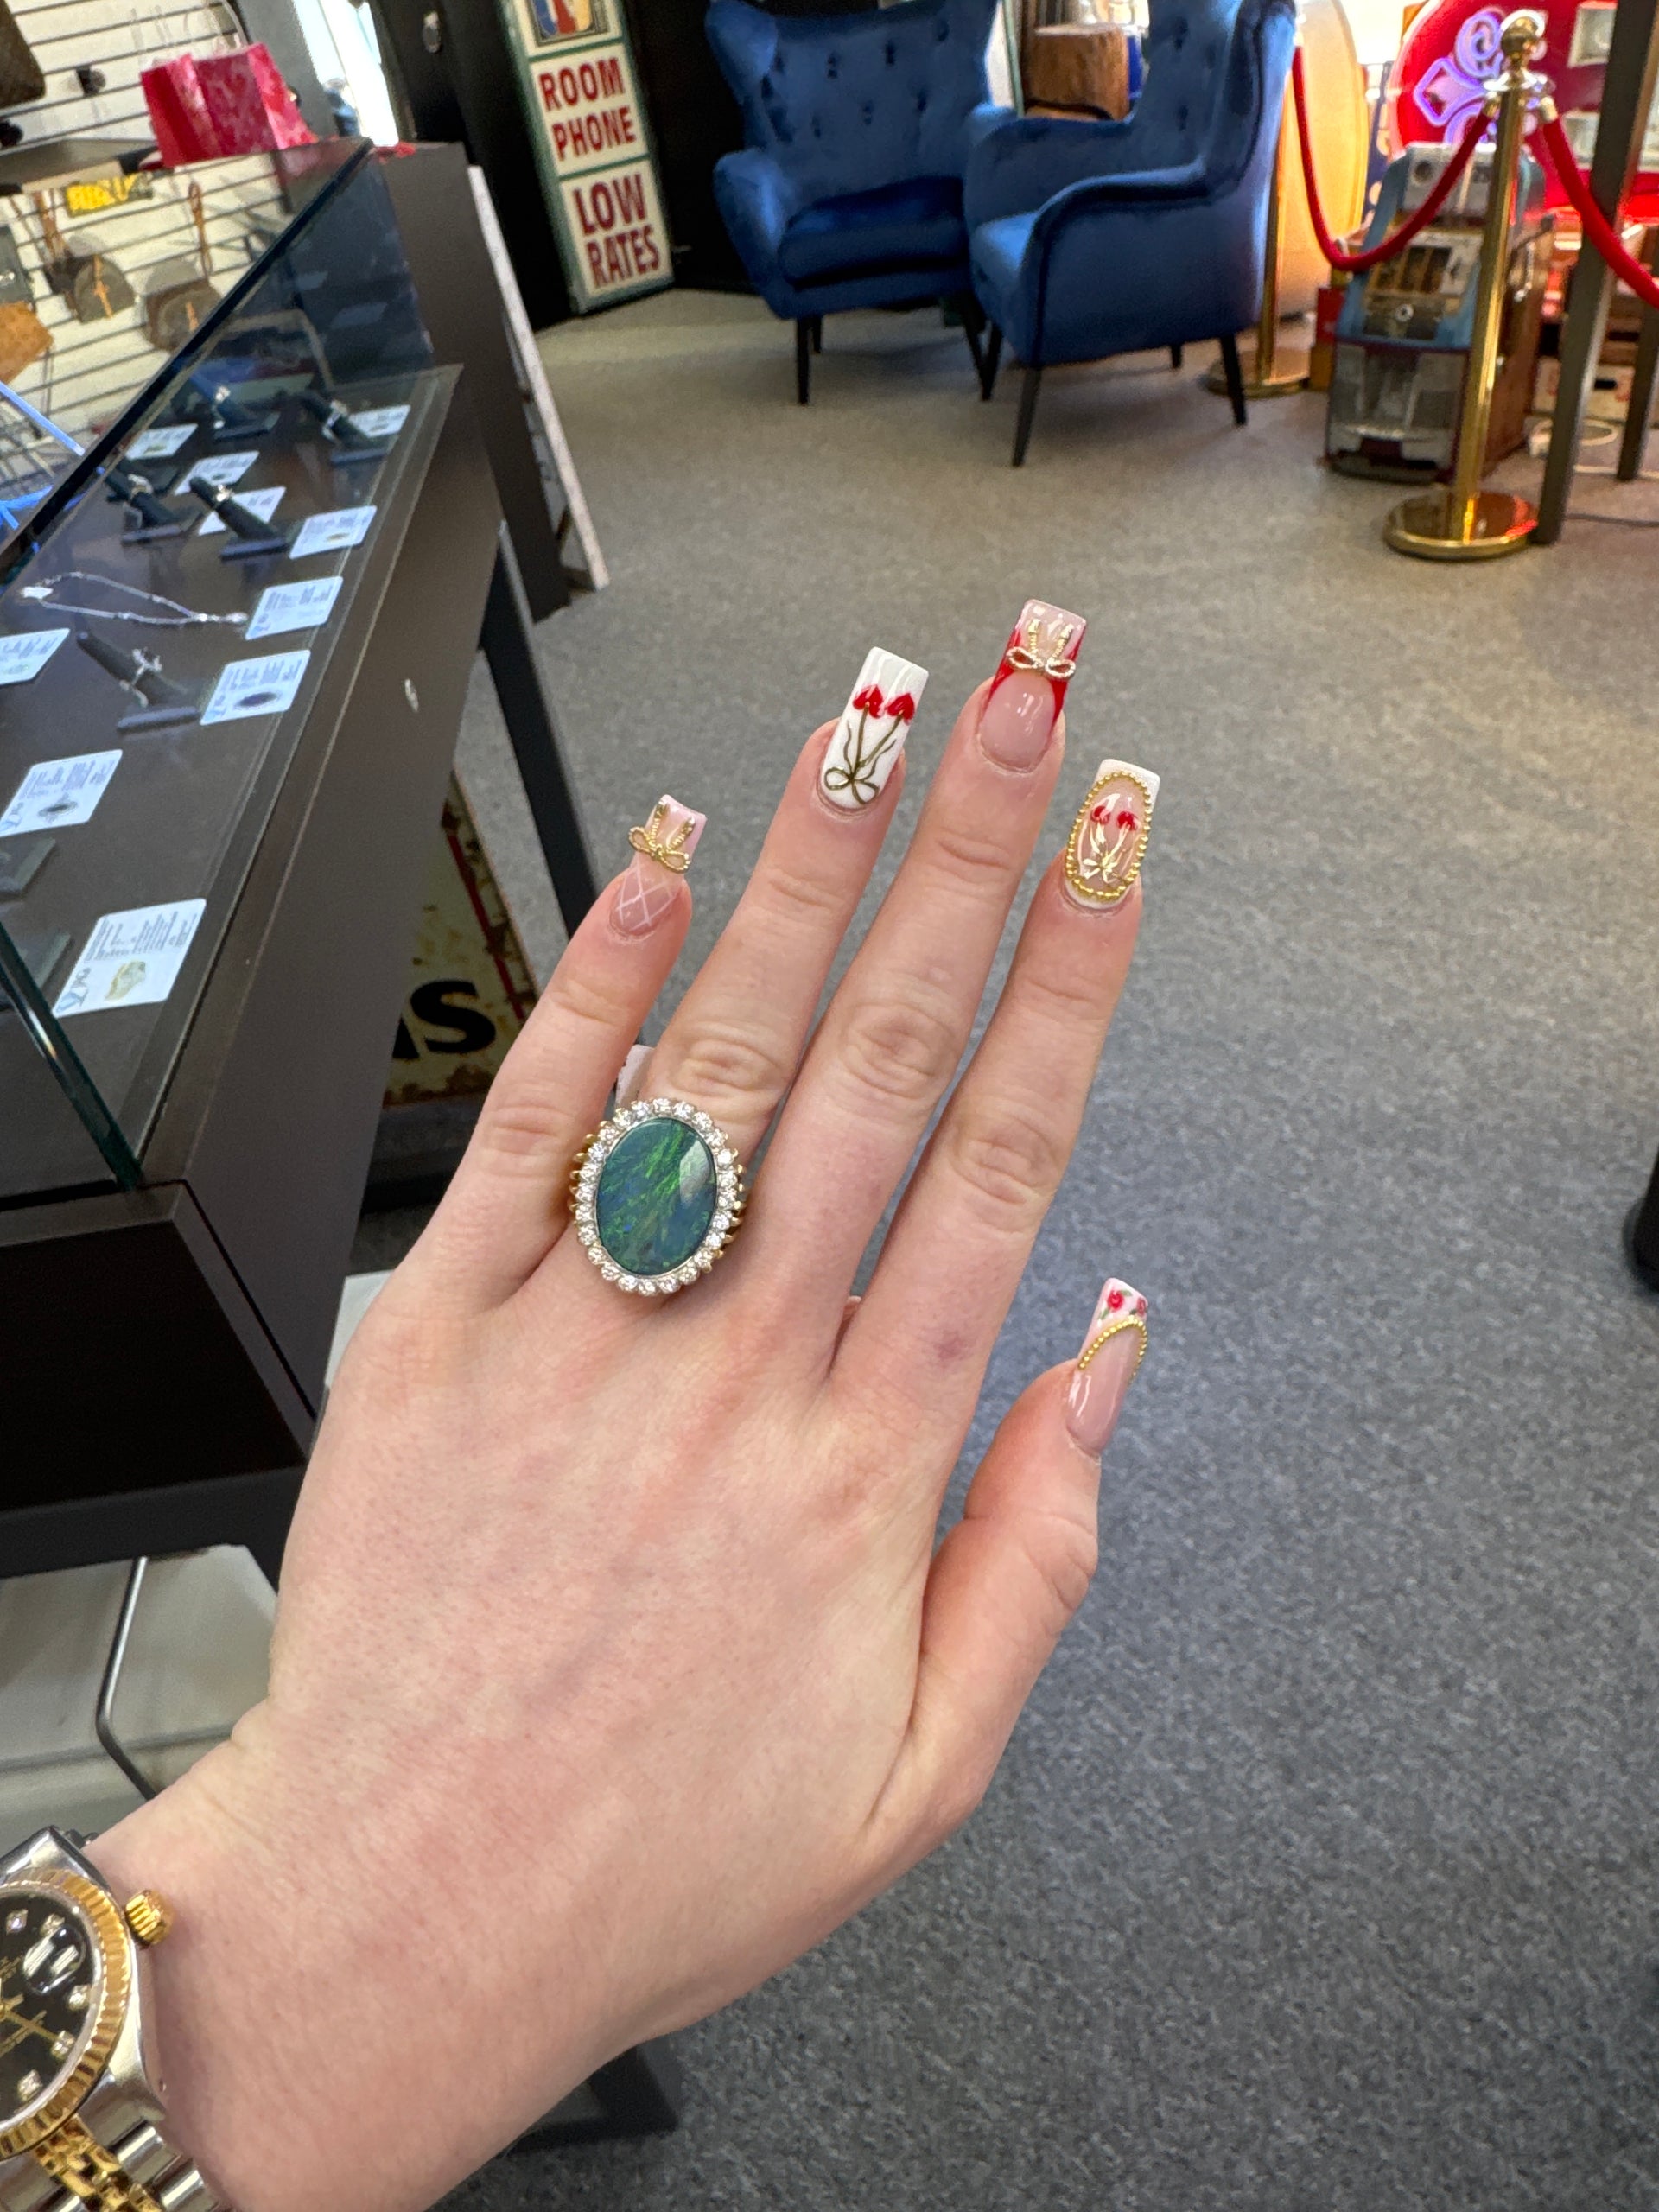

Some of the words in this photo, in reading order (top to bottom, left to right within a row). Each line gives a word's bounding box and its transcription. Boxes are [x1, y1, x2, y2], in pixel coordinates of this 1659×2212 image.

[539, 58, 624, 111] ROOM
[552, 106, 636, 161] PHONE
[573, 174, 646, 236] LOW
[586, 226, 659, 288] RATES
